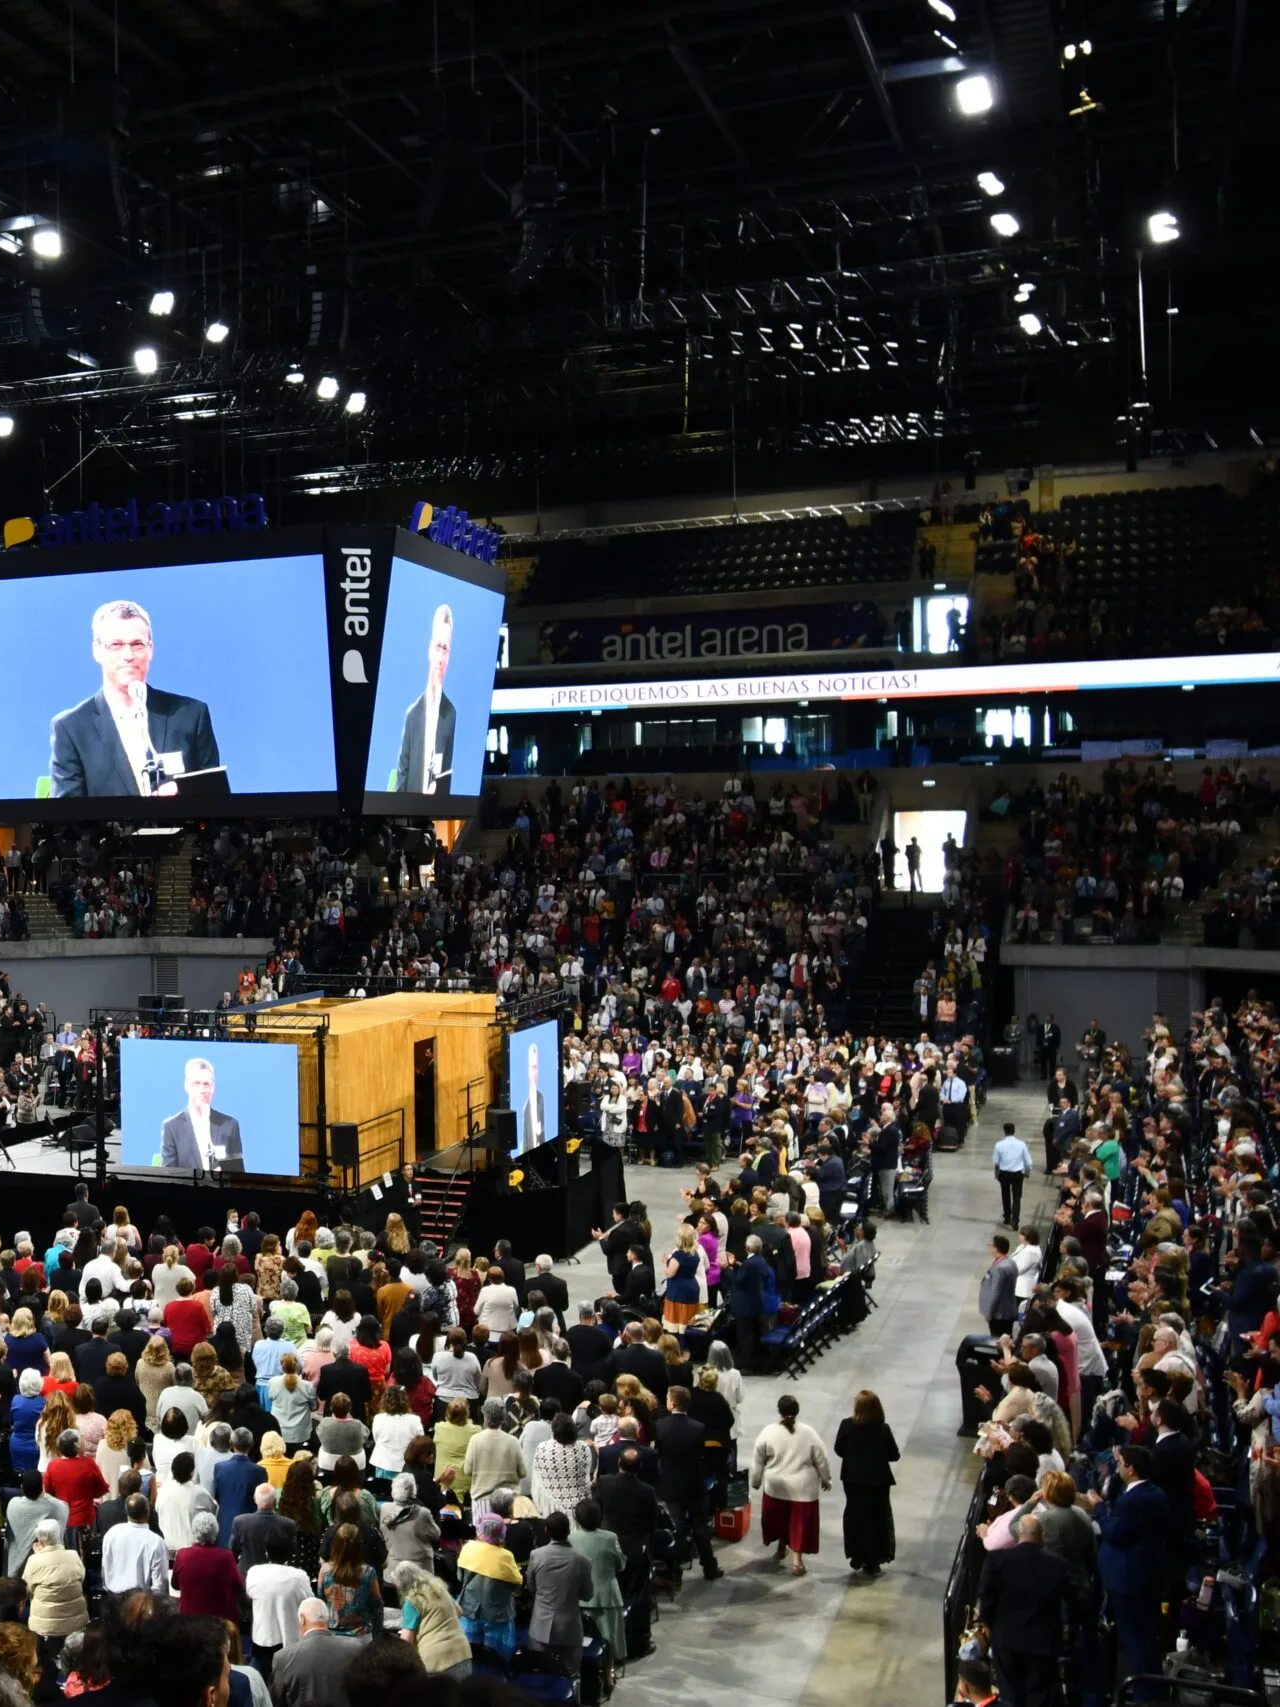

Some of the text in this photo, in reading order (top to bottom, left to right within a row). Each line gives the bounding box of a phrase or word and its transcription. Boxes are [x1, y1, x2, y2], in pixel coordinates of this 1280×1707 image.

[40, 494, 267, 548] antel arena
[339, 547, 372, 636] antel
[602, 623, 809, 662] antel arena
[550, 674, 919, 707] ¡PREDIQUEMOS LAS BUENAS NOTICIAS!
